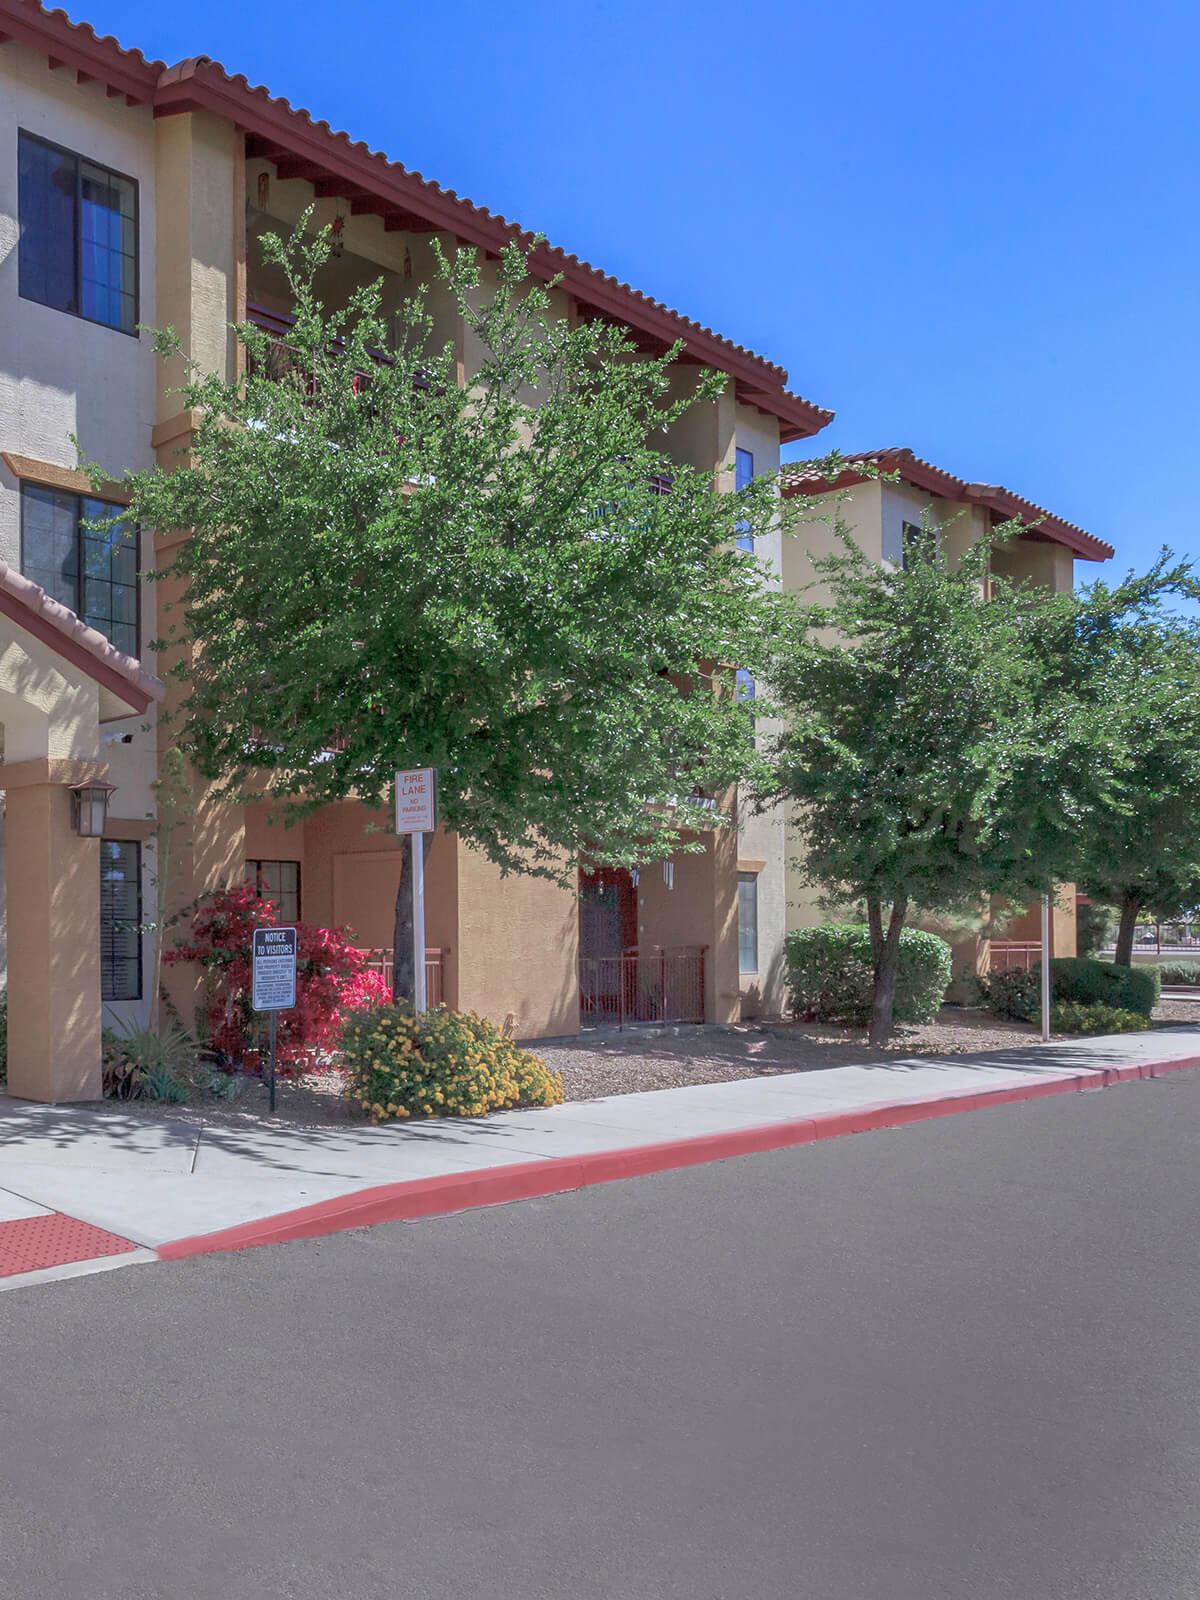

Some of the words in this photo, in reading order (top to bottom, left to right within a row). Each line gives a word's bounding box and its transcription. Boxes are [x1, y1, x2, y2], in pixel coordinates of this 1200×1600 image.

[404, 774, 424, 783] FIRE
[402, 785, 426, 796] LANE
[265, 932, 286, 943] NOTICE
[257, 945, 265, 956] TO
[266, 944, 293, 955] VISITORS
